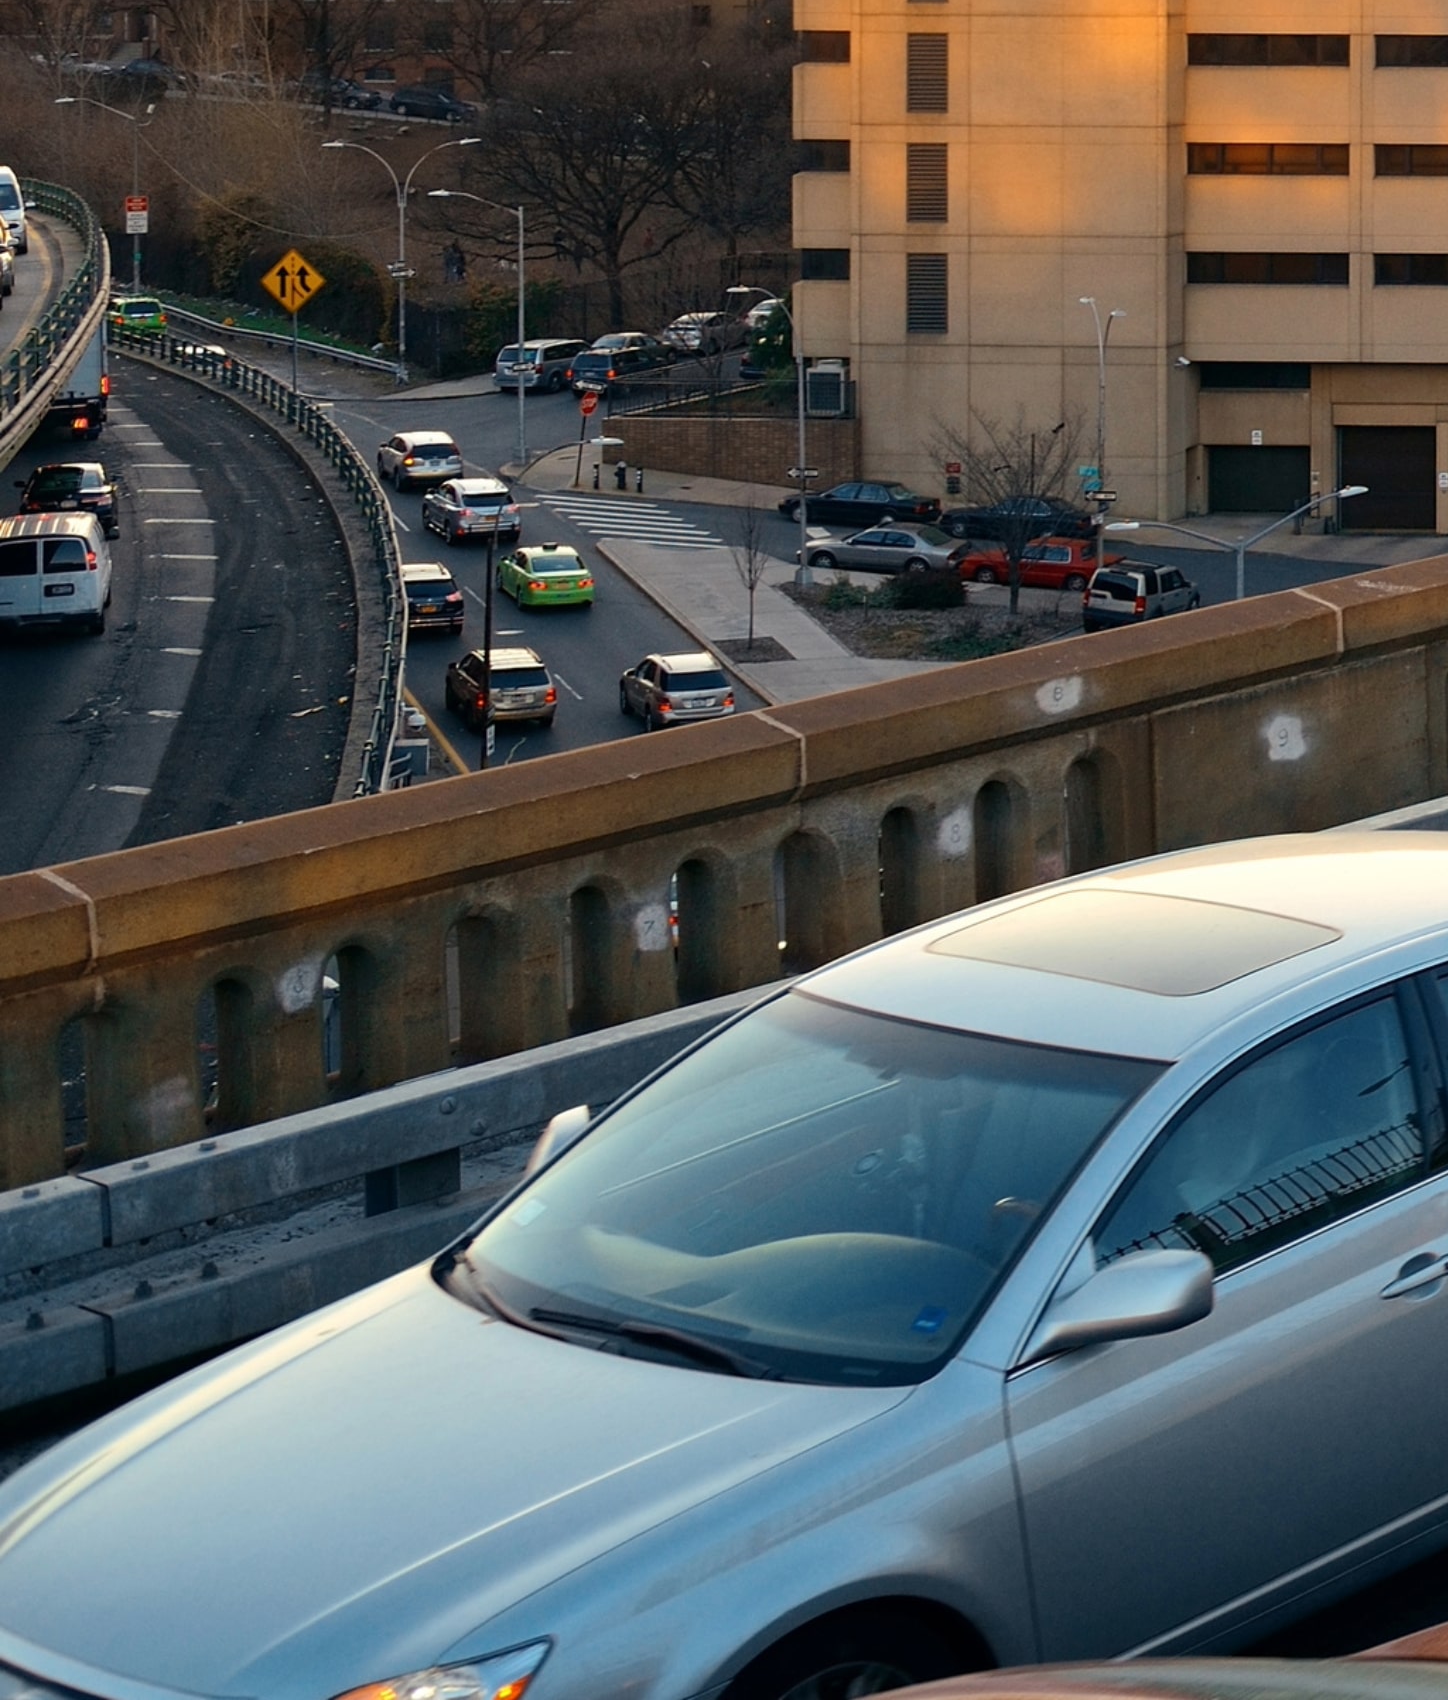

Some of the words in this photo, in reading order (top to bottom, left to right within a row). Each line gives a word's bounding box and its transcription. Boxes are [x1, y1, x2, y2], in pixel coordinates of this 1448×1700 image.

[1279, 728, 1288, 748] 9
[951, 823, 961, 843] 8
[644, 920, 655, 935] 7
